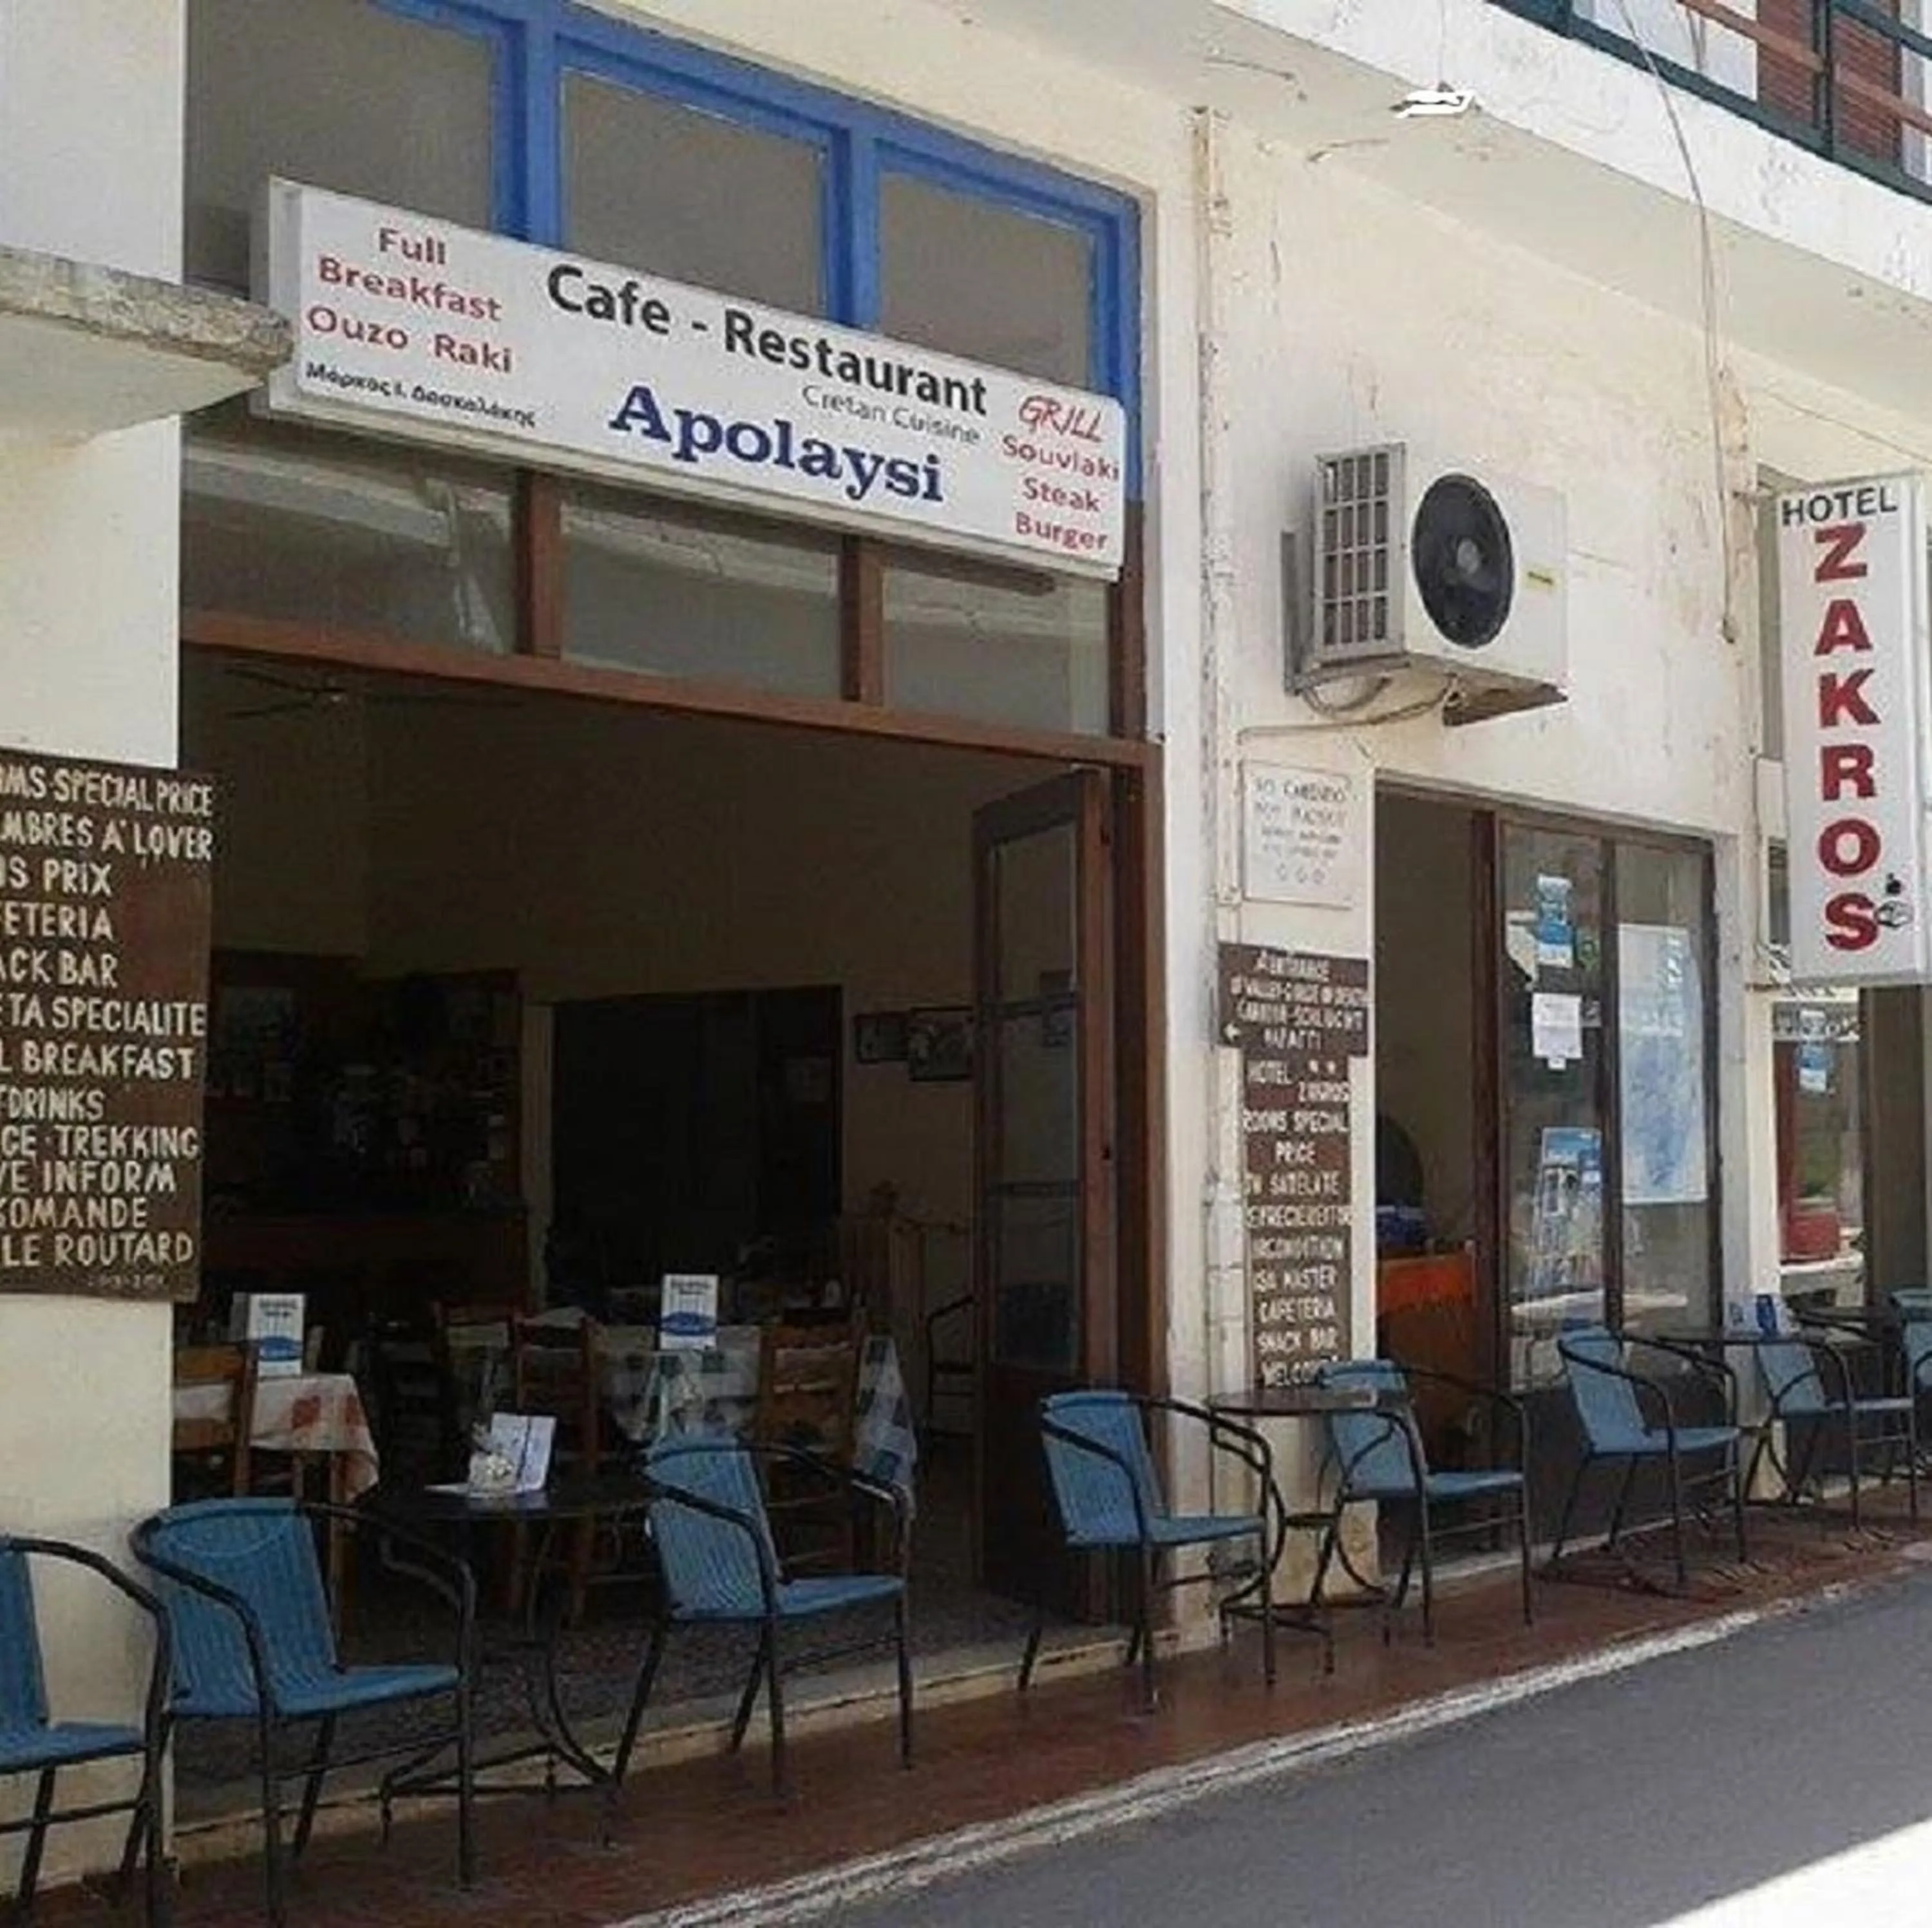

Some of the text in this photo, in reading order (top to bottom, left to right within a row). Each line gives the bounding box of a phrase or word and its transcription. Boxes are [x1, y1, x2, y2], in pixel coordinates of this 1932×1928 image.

[379, 227, 446, 265] Full
[317, 256, 503, 322] Breakfast
[307, 305, 512, 373] Ouzo Raki
[547, 264, 670, 335] Cafe
[724, 308, 987, 415] Restaurant
[802, 385, 979, 446] Cretan Cuisine
[1019, 395, 1103, 443] GRILL
[609, 384, 944, 502] Apolaysi
[1003, 435, 1119, 481] Souvlaki
[1023, 478, 1101, 514] Steak
[1783, 486, 1898, 526] HOTEL
[1015, 513, 1108, 551] Burger
[1814, 521, 1881, 951] ZAKROS
[53, 768, 154, 813] SPECIAL
[156, 778, 213, 817] PRICE
[134, 820, 214, 862] LOVER
[43, 858, 113, 897] PRIX
[5, 901, 114, 941] ETERIA
[58, 949, 118, 988] BAR
[52, 996, 208, 1037] SPECIALITE
[21, 1039, 194, 1079] BREAKFAST
[1247, 1060, 1293, 1085] HOTEL
[55, 1124, 200, 1159] TREKKING
[1293, 1110, 1349, 1133] SPECIAL
[1276, 1140, 1316, 1165] PRICE
[43, 1160, 176, 1193] INFORM
[2, 1231, 193, 1267] LE ROUTARD
